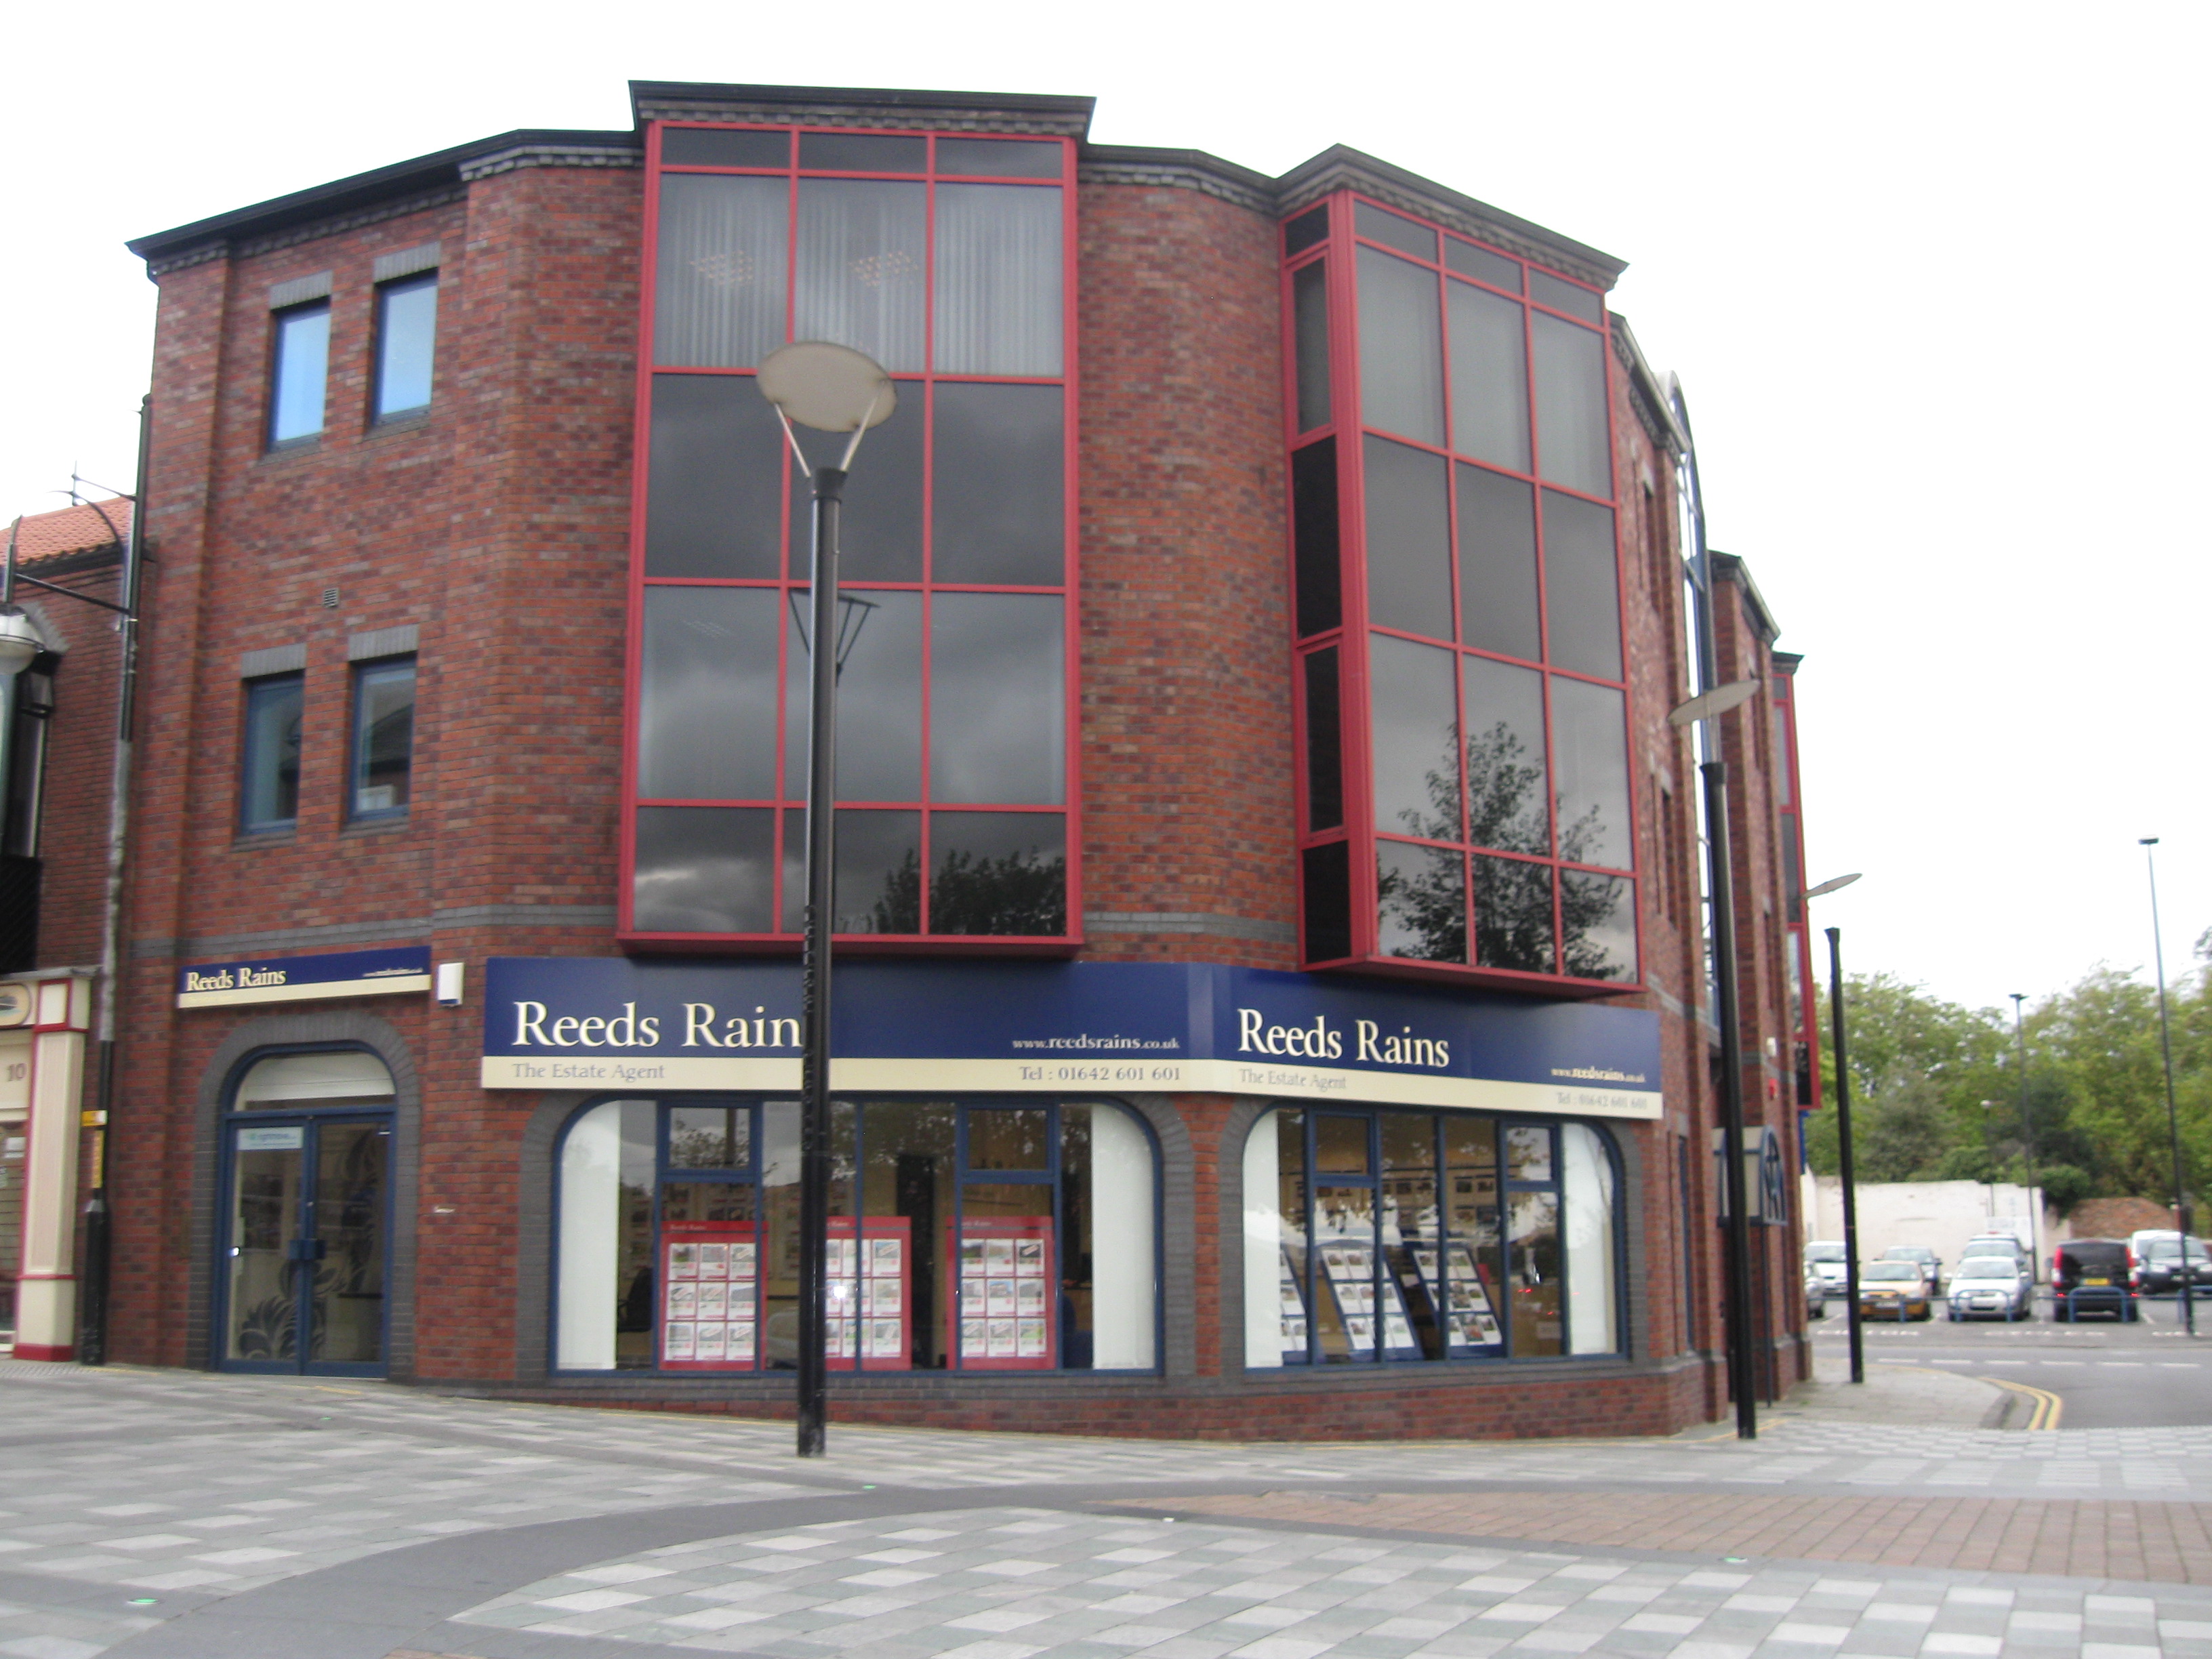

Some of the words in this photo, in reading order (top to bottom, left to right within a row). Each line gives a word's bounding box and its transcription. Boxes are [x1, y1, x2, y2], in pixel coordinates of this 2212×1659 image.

[186, 968, 234, 991] Reeds
[239, 967, 287, 987] Rains
[512, 1000, 661, 1048] Reeds
[681, 1002, 803, 1048] Rain
[1012, 1034, 1181, 1049] www.reedsrains.co.uk
[1237, 1008, 1343, 1059] Reeds
[1356, 1019, 1450, 1067] Rains
[7, 1063, 27, 1082] 10
[512, 1063, 548, 1078] The
[552, 1063, 605, 1079] Estate
[611, 1063, 665, 1082] Agent
[1019, 1066, 1043, 1080] Tel
[1057, 1067, 1110, 1080] 01642
[1116, 1067, 1144, 1080] 601
[1151, 1067, 1181, 1080] 601
[1239, 1068, 1264, 1084] The
[1267, 1069, 1307, 1087] Estate
[1310, 1074, 1347, 1092] Agent
